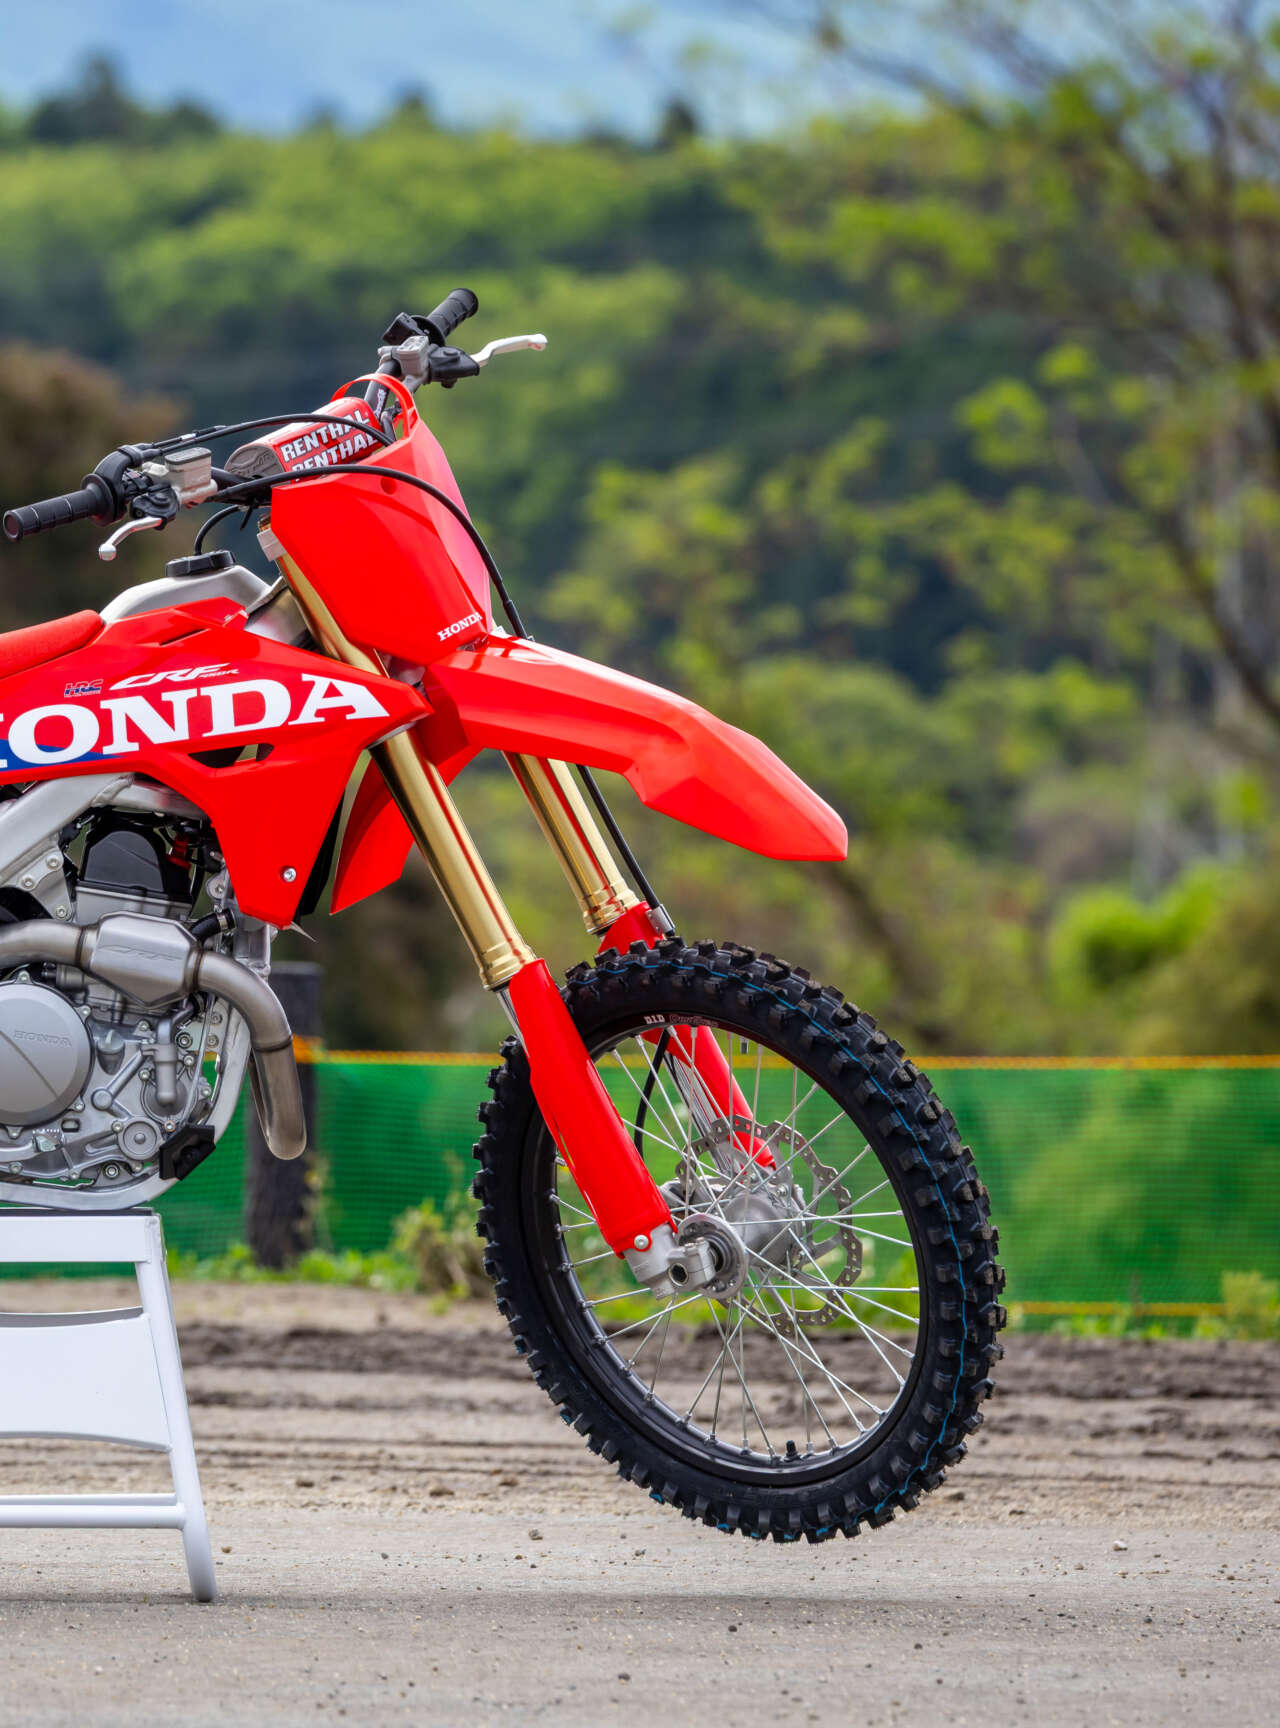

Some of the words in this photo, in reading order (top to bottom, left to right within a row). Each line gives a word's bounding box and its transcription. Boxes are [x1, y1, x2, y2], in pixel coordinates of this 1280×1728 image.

[280, 409, 371, 462] RENTHAL
[437, 611, 483, 642] HONDA
[109, 662, 231, 691] CRF
